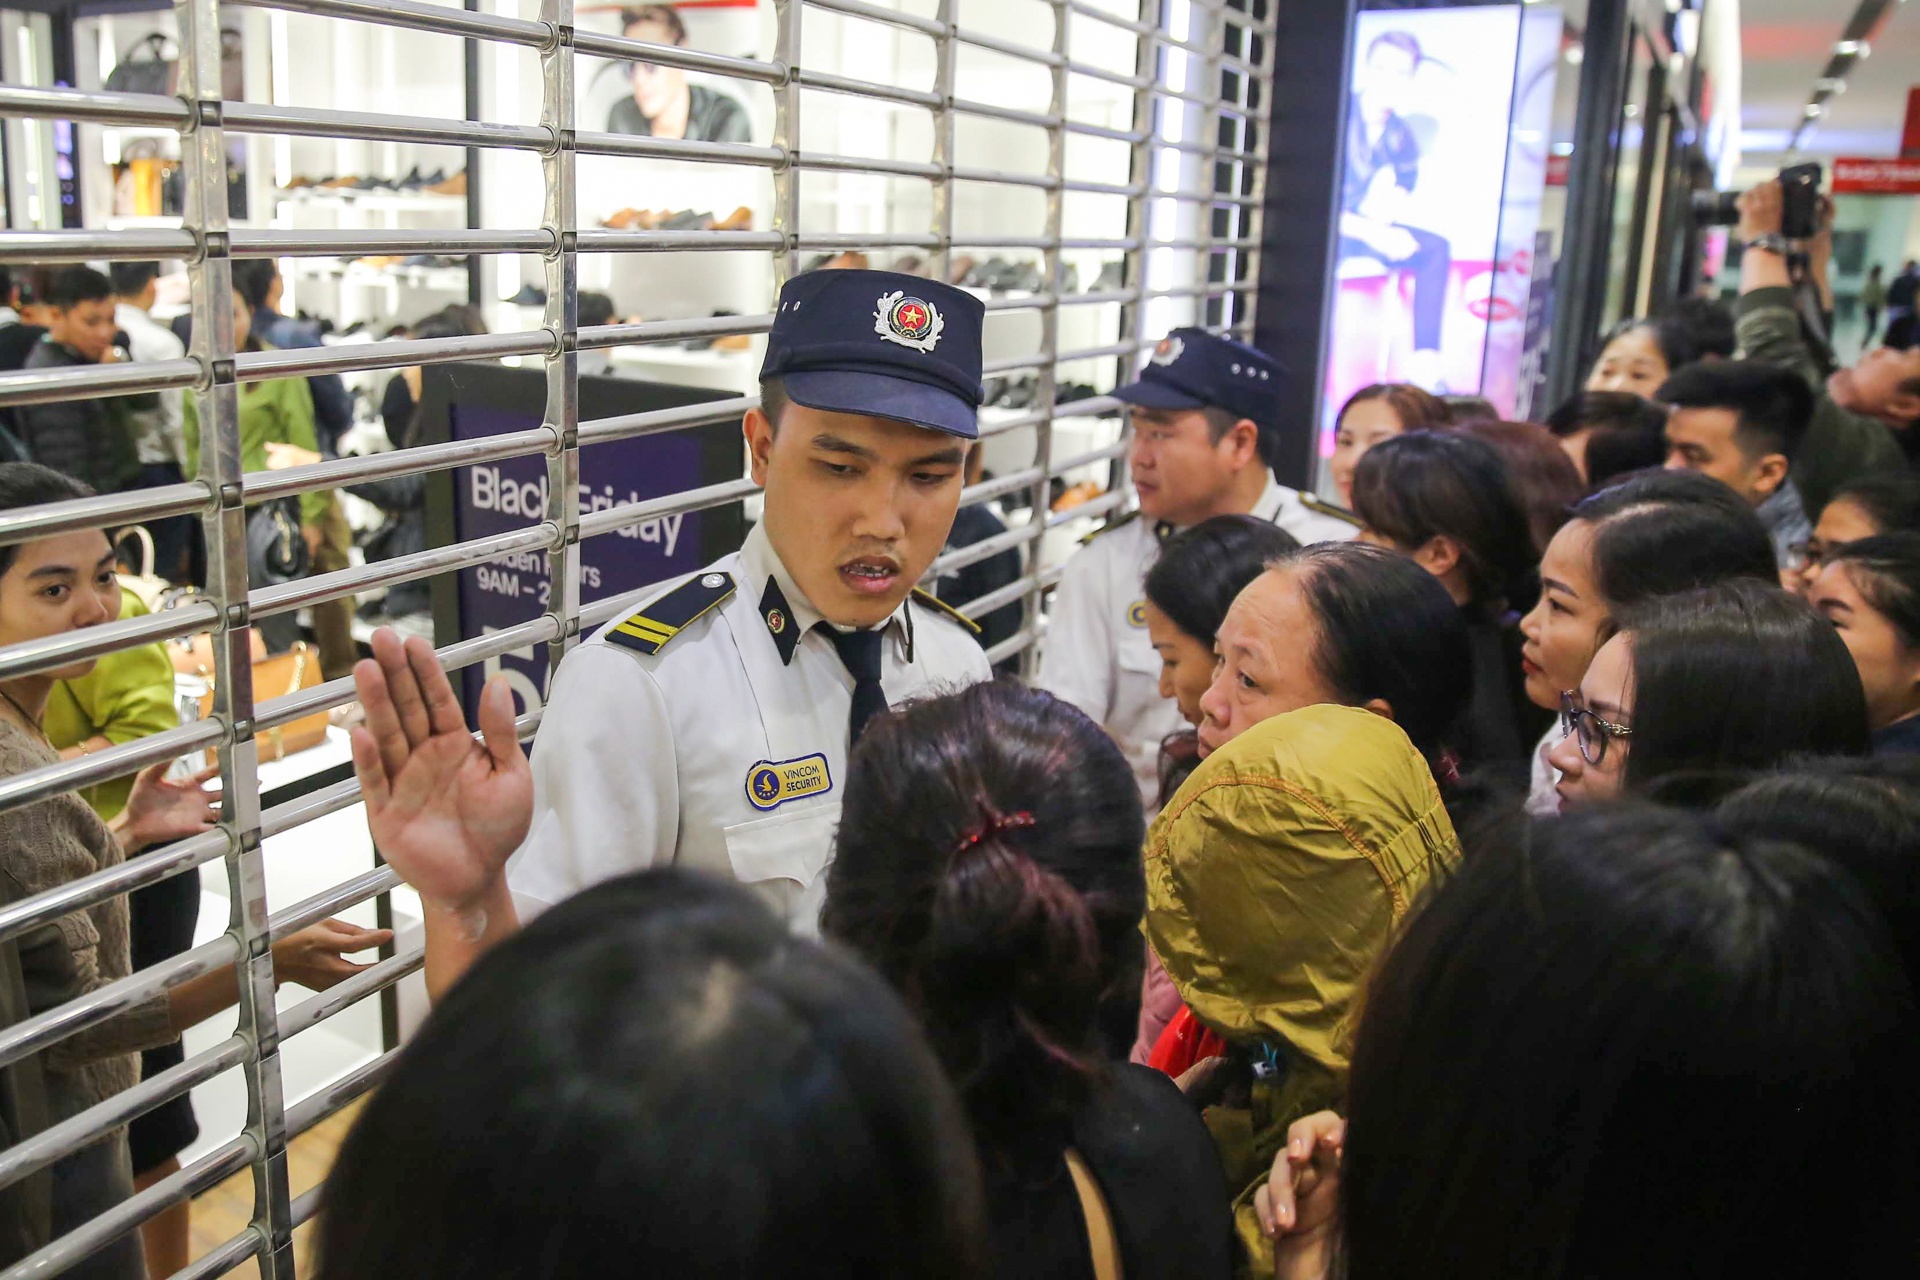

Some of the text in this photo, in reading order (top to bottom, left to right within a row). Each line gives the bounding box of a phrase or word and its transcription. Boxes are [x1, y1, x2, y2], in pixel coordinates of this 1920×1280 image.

[476, 566, 519, 598] 9AM
[783, 764, 820, 780] VINCOM
[786, 775, 821, 792] SECURITY
